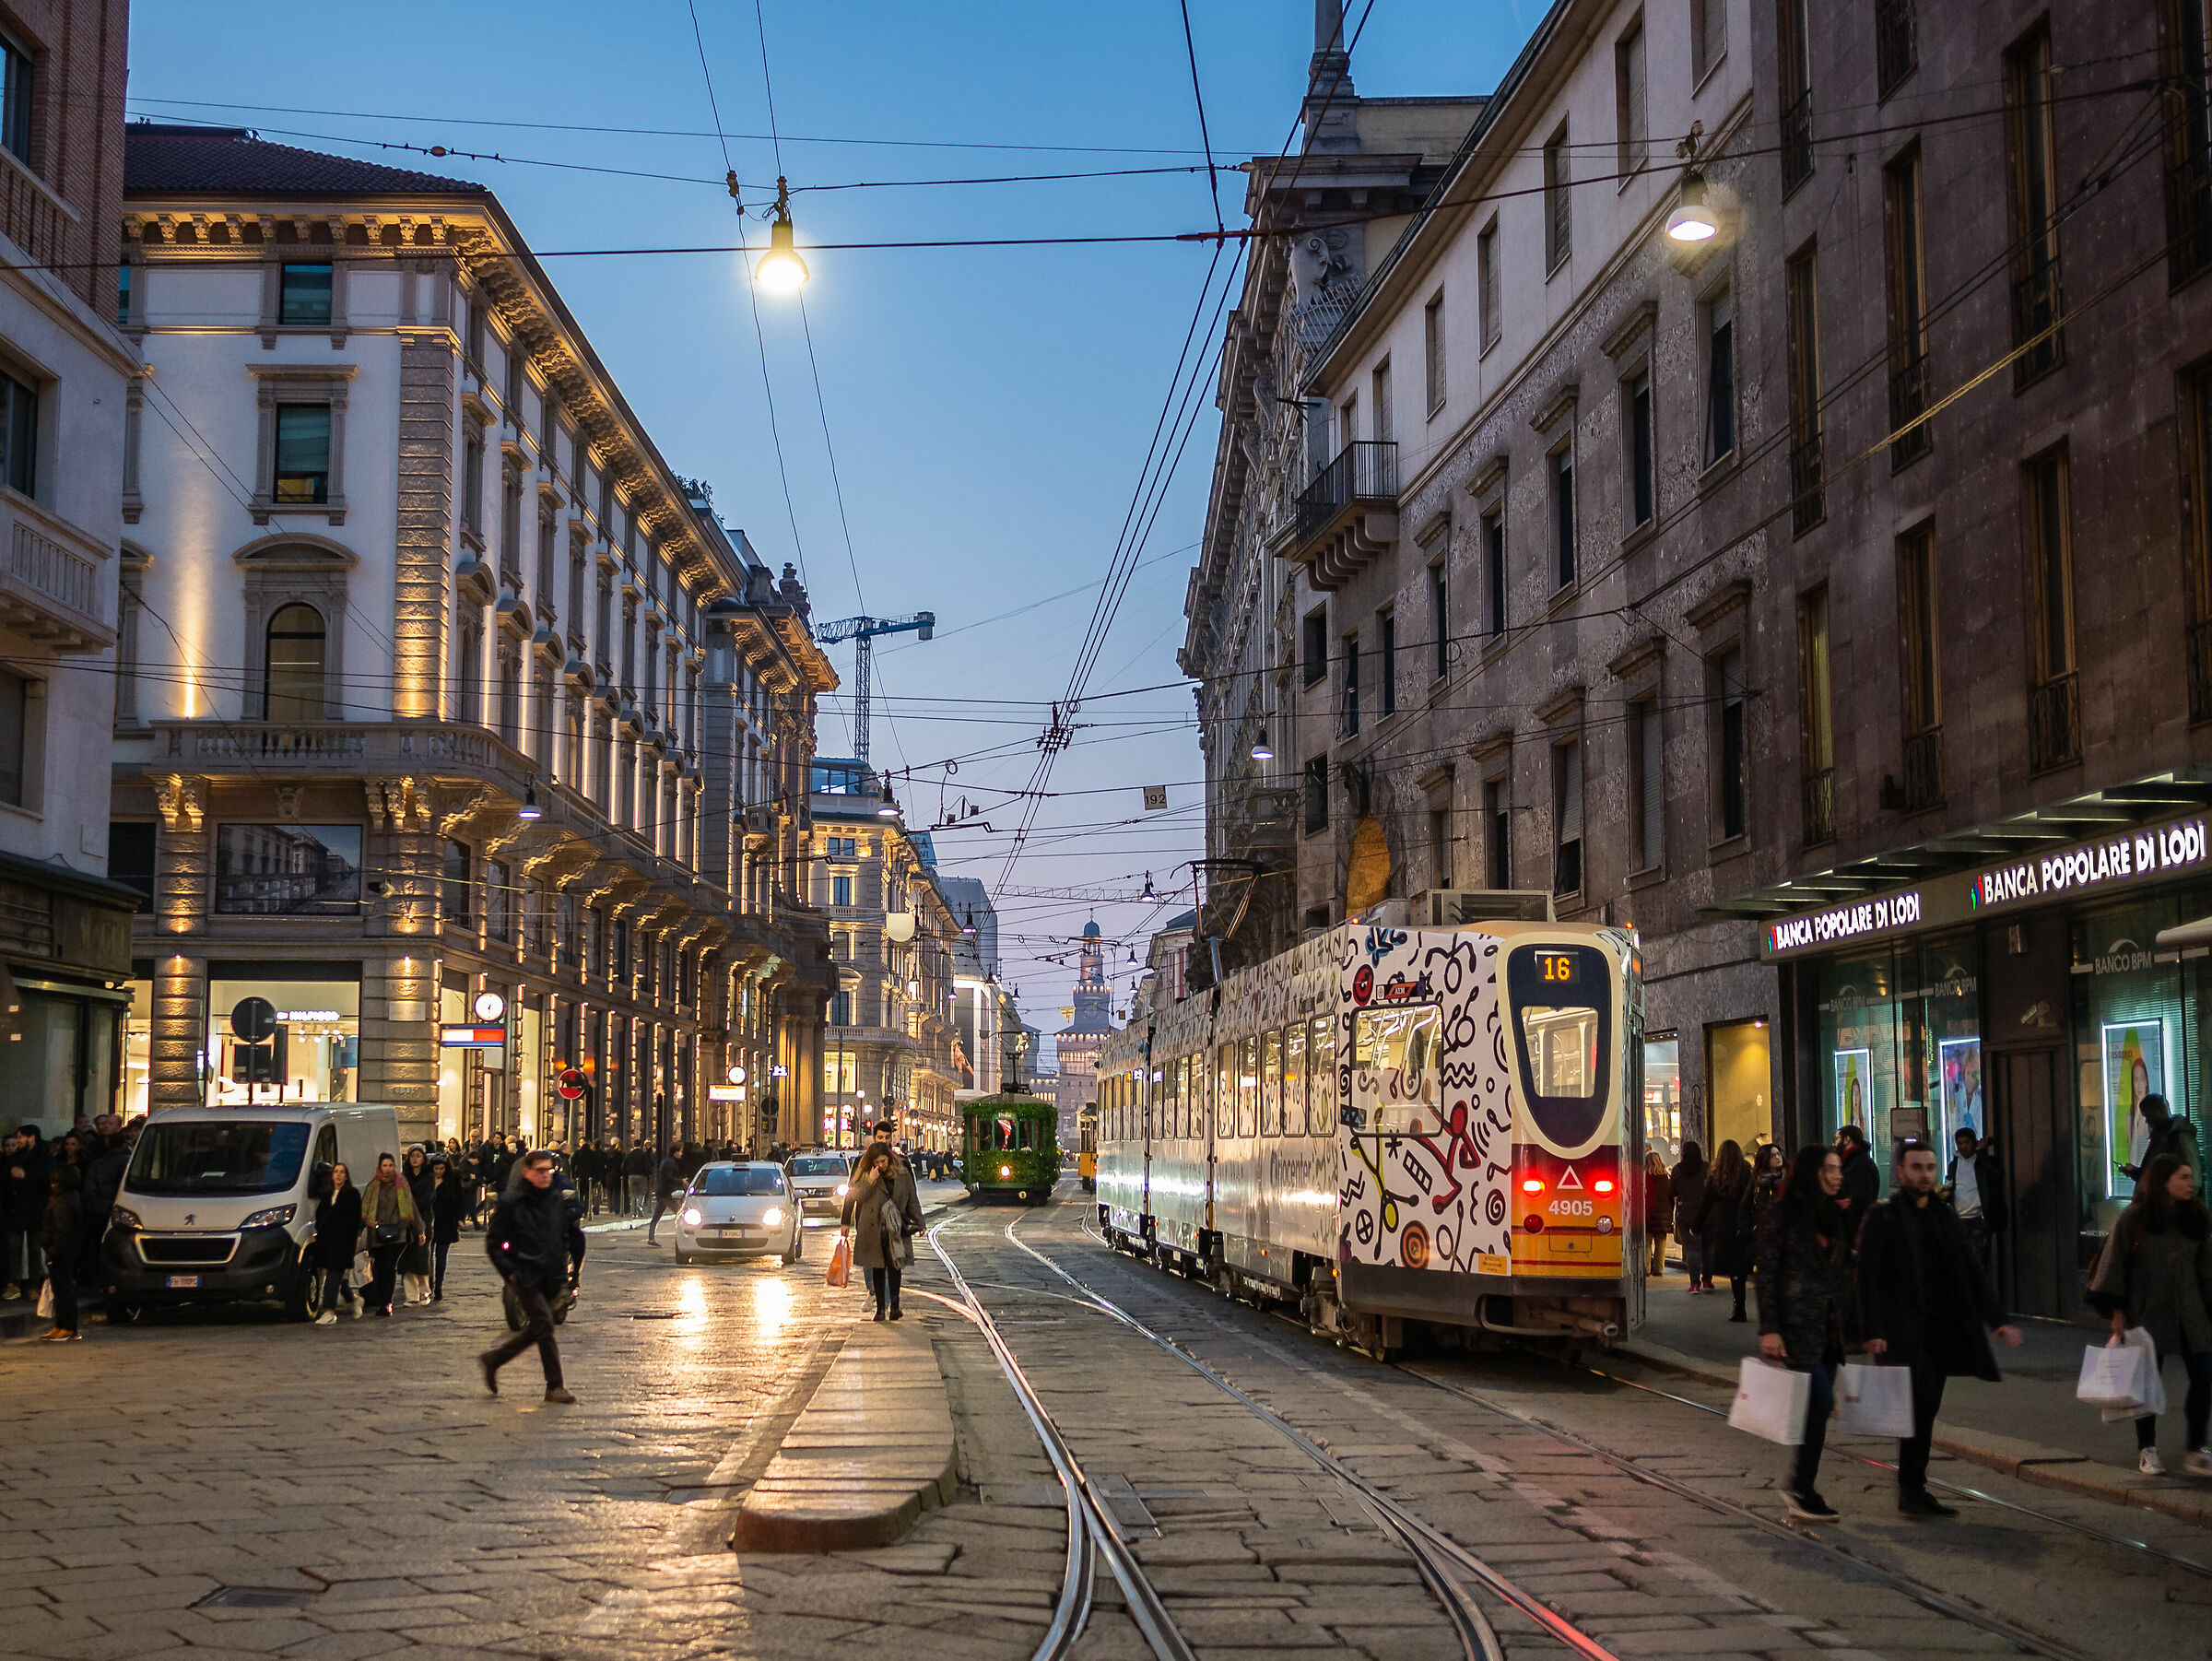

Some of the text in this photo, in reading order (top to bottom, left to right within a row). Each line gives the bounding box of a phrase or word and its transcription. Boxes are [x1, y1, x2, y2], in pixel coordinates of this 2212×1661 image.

[1146, 795, 1165, 805] 192
[1984, 823, 2206, 904] BANCA POPOLARE DI LODI
[1776, 892, 1920, 950] BANCA POPOLARE DI LODI
[1545, 957, 1570, 980] 16
[2095, 950, 2152, 975] BANCO BPM
[1548, 1199, 1593, 1216] 4905
